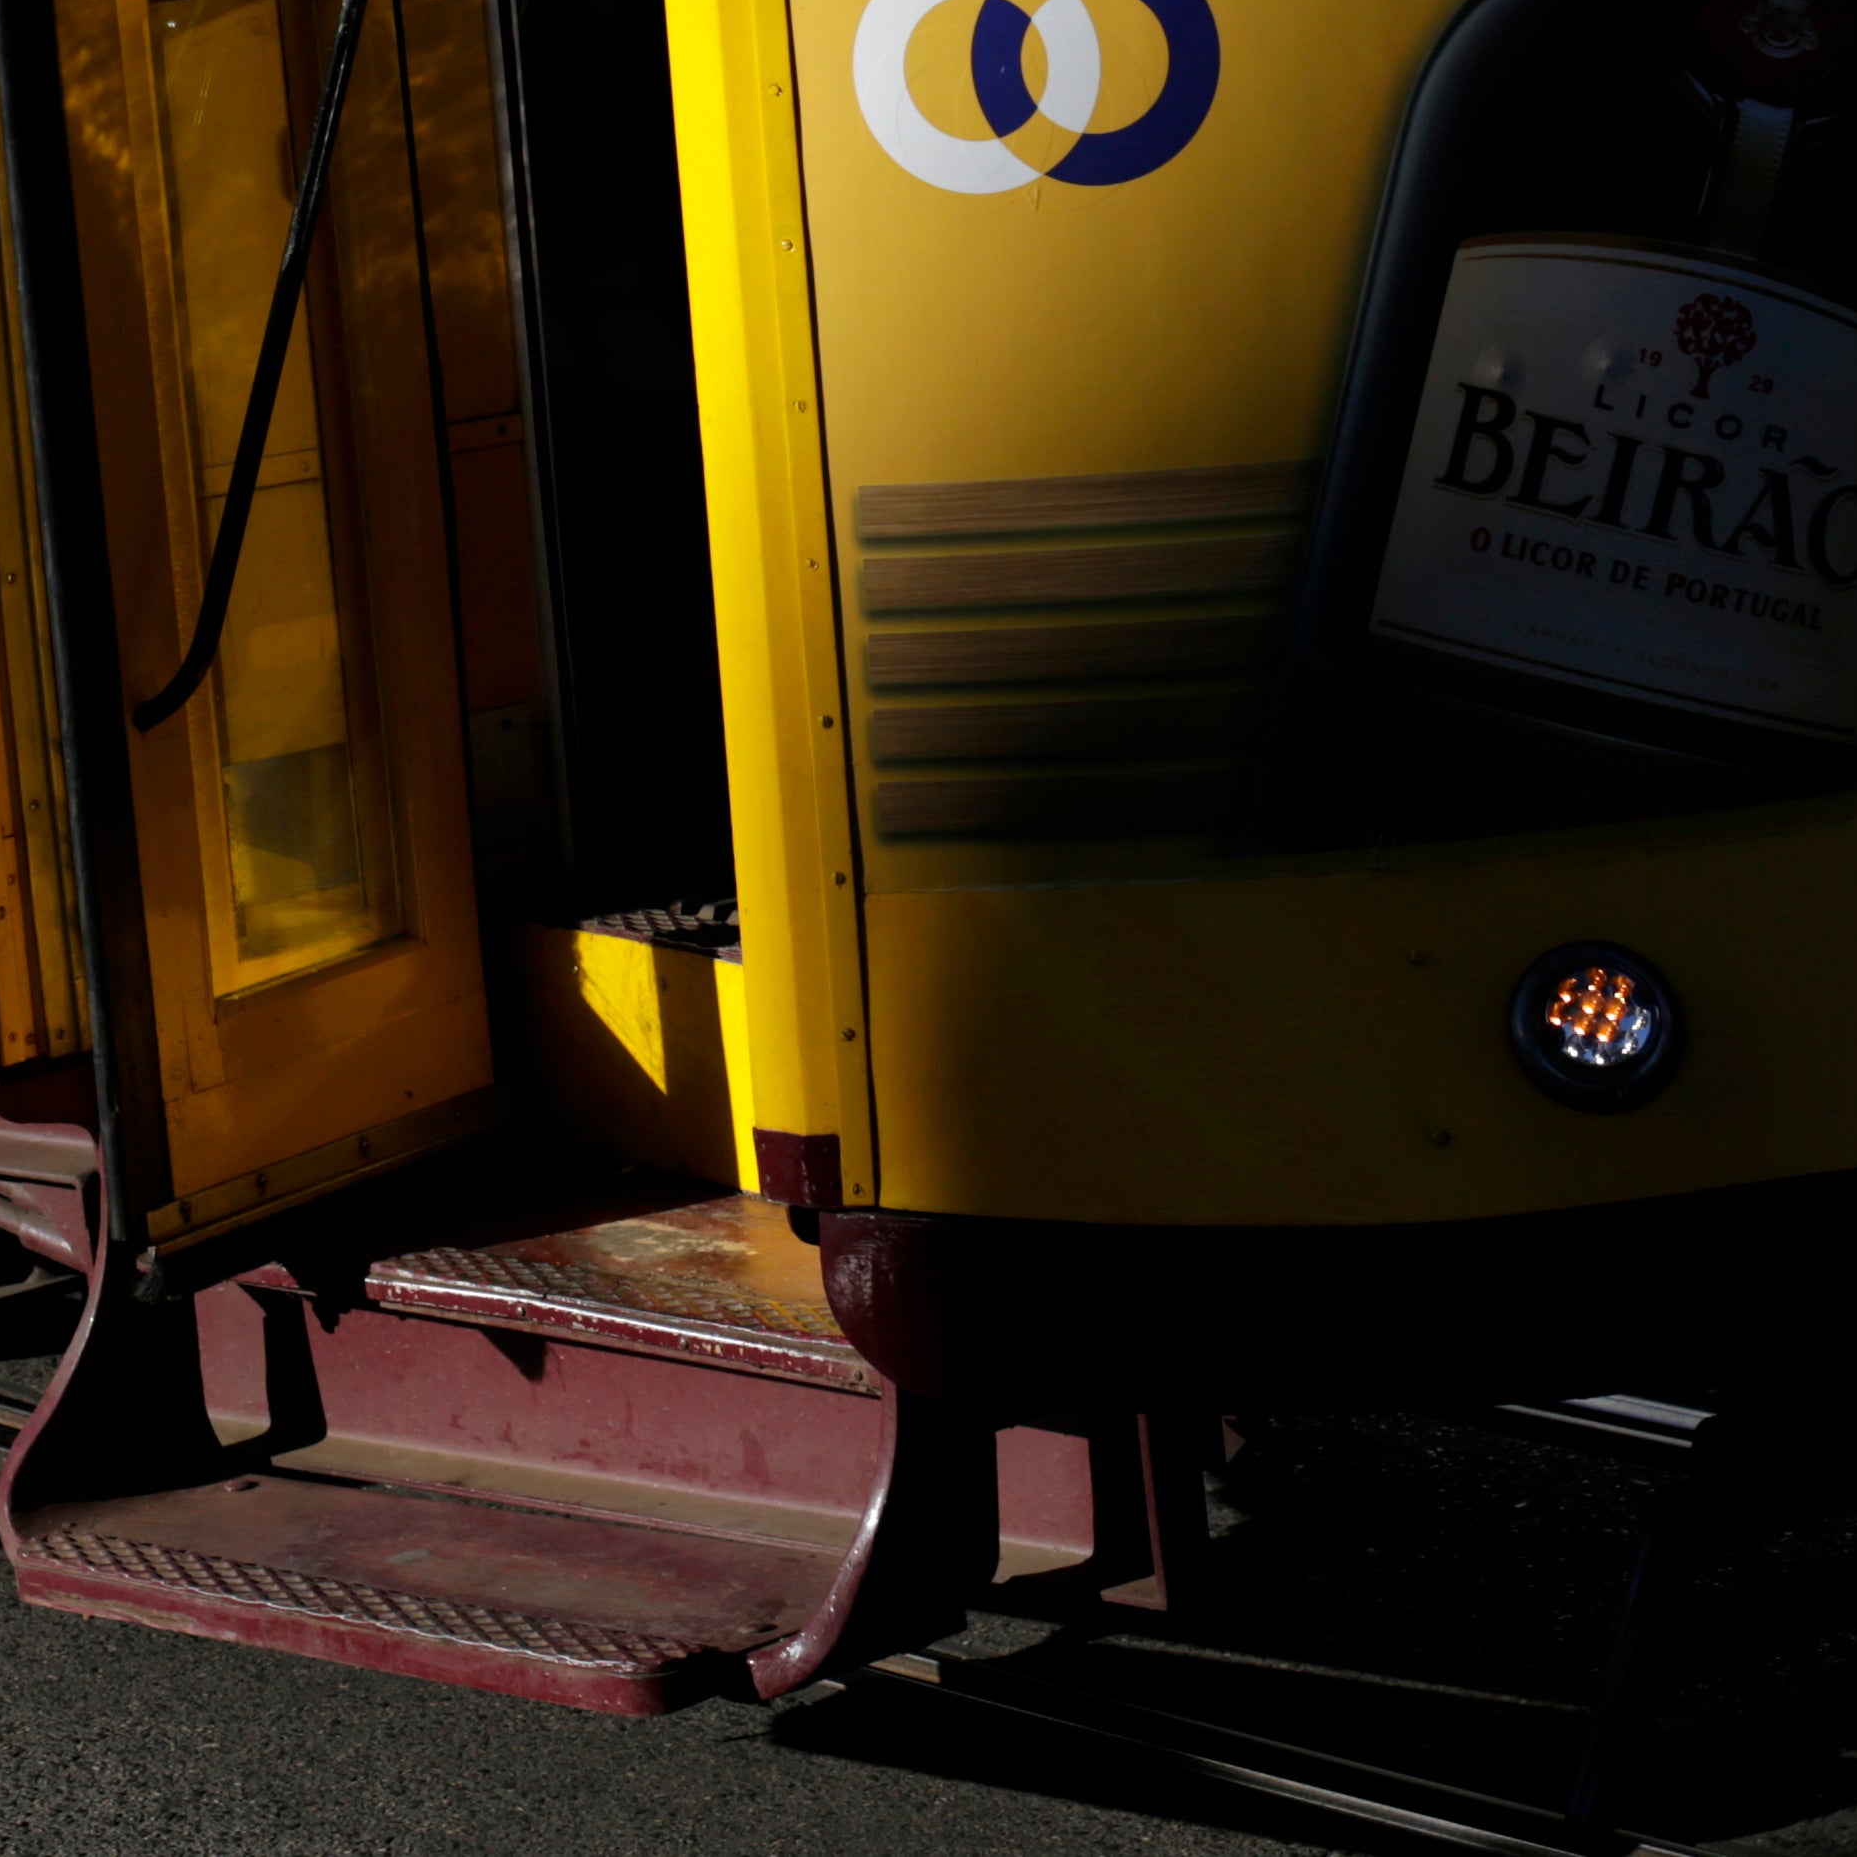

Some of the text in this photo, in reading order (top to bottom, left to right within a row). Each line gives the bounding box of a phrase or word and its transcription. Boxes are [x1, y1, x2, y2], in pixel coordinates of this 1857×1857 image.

[1637, 347, 1775, 395] 19 29
[1593, 384, 1788, 453] LICOR
[1469, 527, 1824, 632] O LICOR DE PORTUGAL
